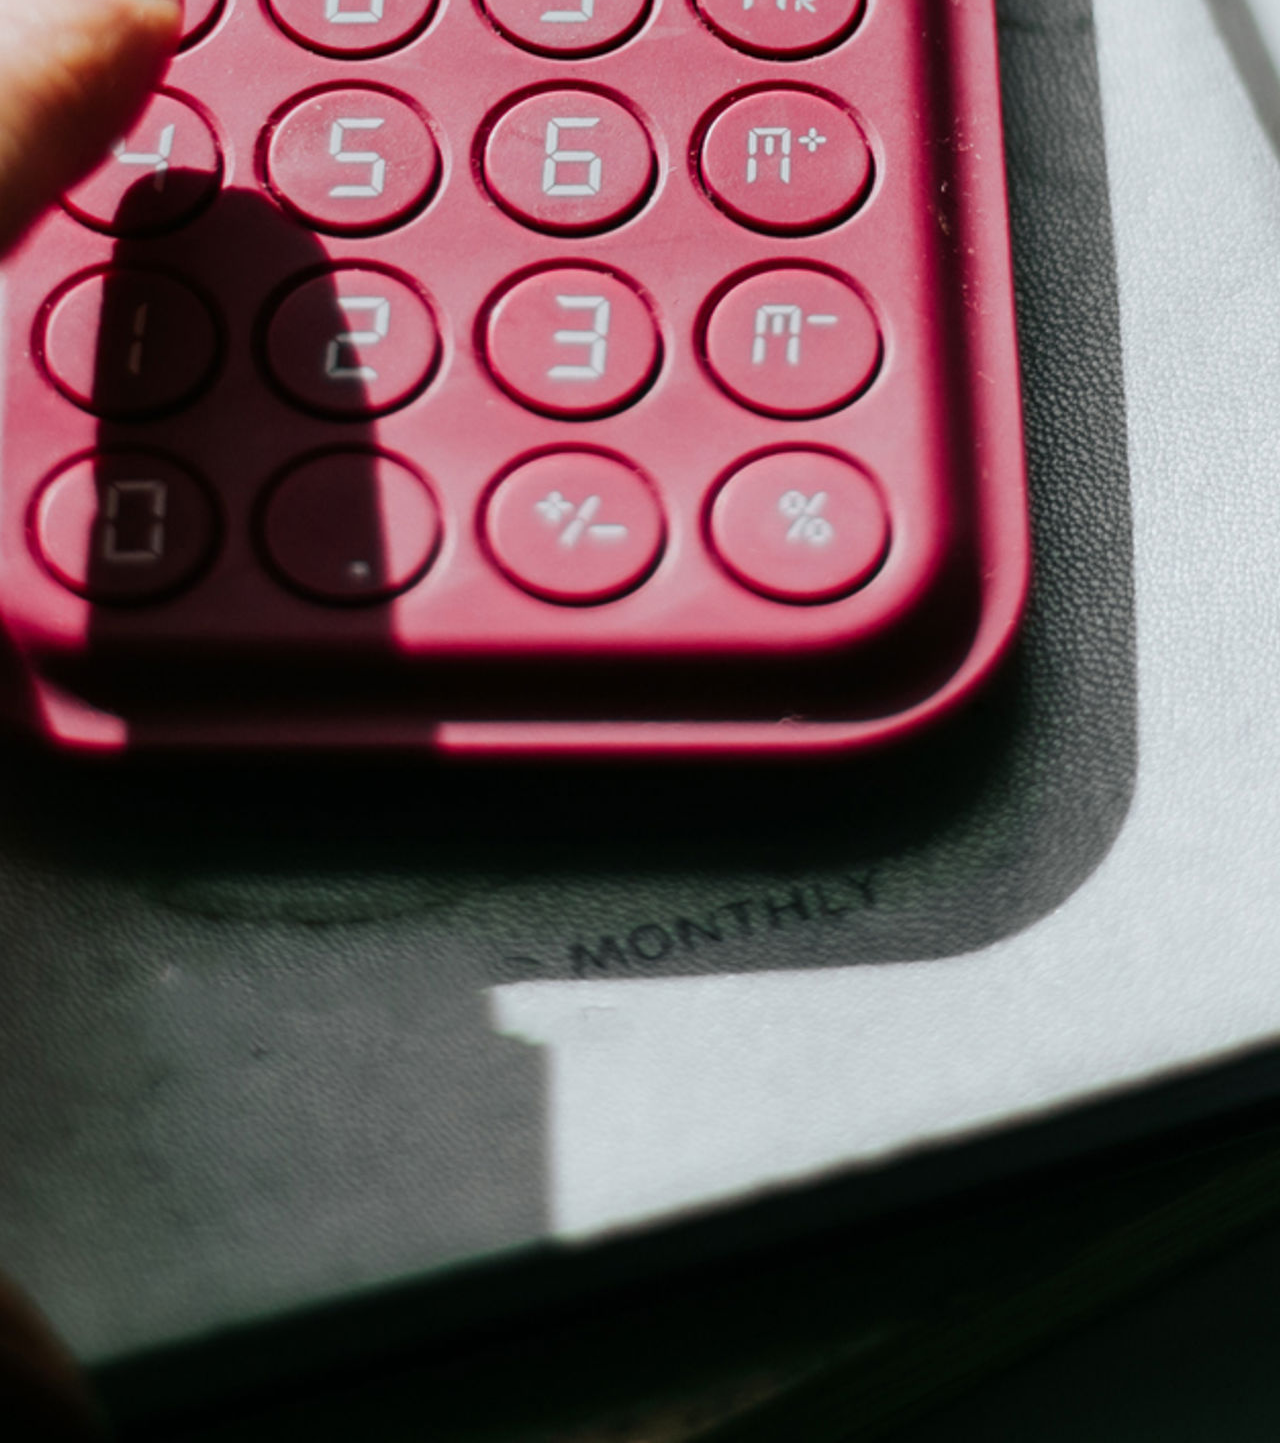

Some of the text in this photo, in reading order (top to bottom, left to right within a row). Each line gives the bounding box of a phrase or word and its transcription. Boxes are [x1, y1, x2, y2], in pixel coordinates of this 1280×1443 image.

[111, 116, 828, 198] 4 5 6 M+
[325, 295, 392, 381] 2
[546, 295, 611, 381] 3
[751, 304, 839, 366] M-
[777, 489, 834, 547] %
[566, 865, 883, 978] MONTHLY
